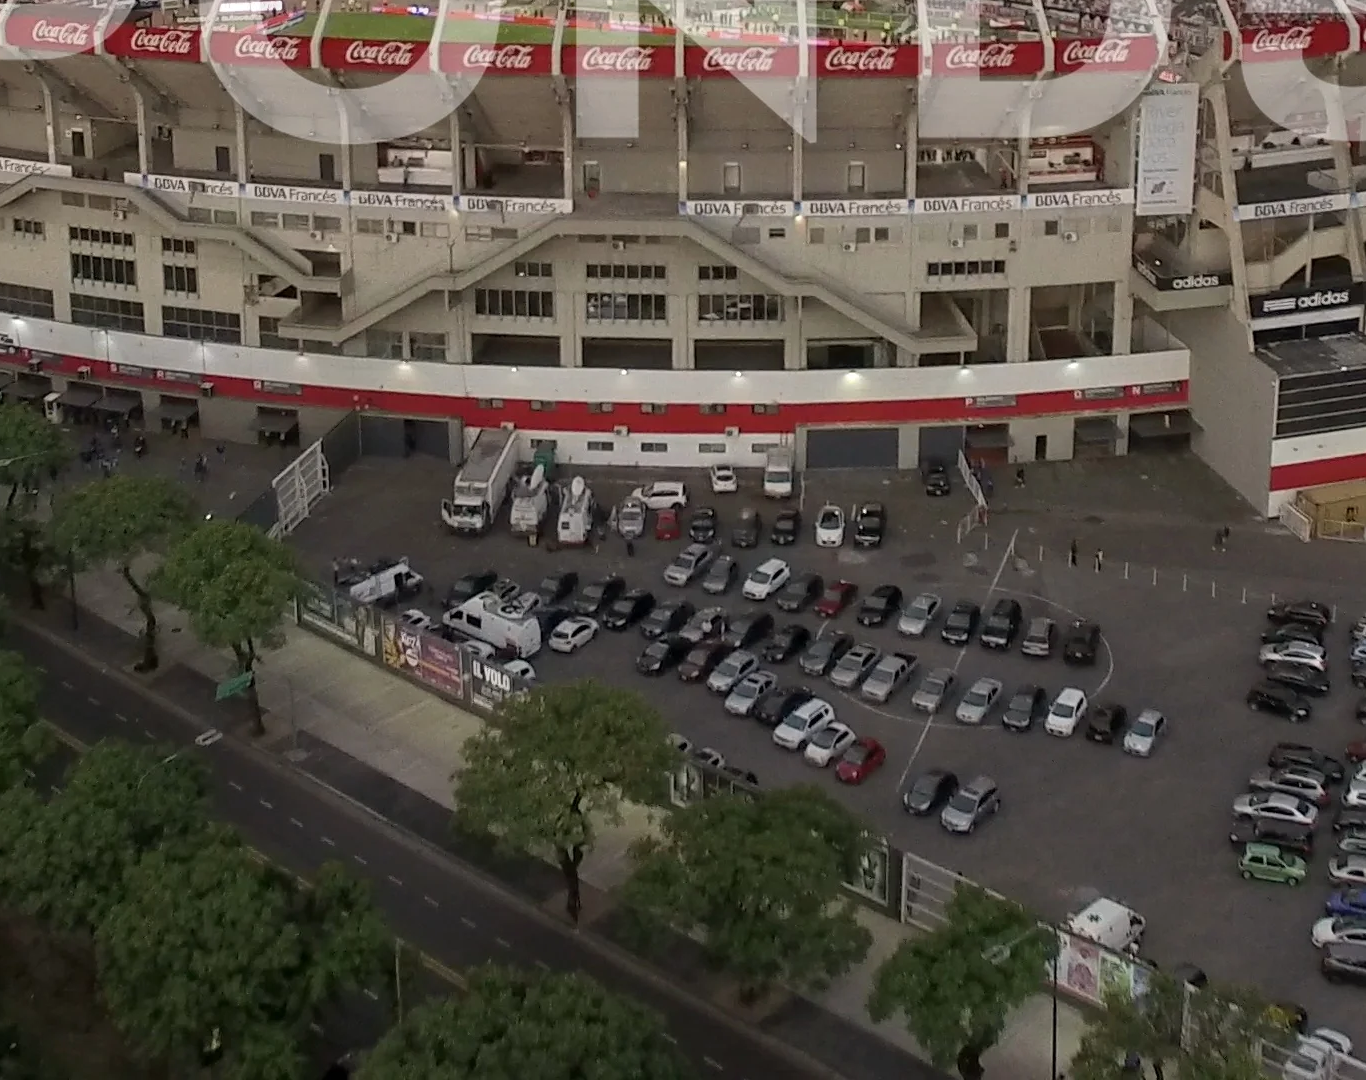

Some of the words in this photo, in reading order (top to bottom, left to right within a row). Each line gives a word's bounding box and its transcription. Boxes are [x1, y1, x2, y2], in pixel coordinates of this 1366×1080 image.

[253, 183, 285, 199] BBVA
[289, 187, 337, 204] Francés
[1035, 194, 1069, 207] BBVA
[1072, 190, 1122, 206] Francés
[694, 202, 731, 215] BBVA
[810, 202, 845, 215] BBVA
[848, 199, 902, 214] Francés
[923, 199, 959, 212] BBVA
[961, 194, 1013, 211] Francés
[1255, 203, 1286, 217] BBVA
[1288, 197, 1333, 214] Francés
[1173, 274, 1219, 289] adidas
[1298, 291, 1349, 308] adidas
